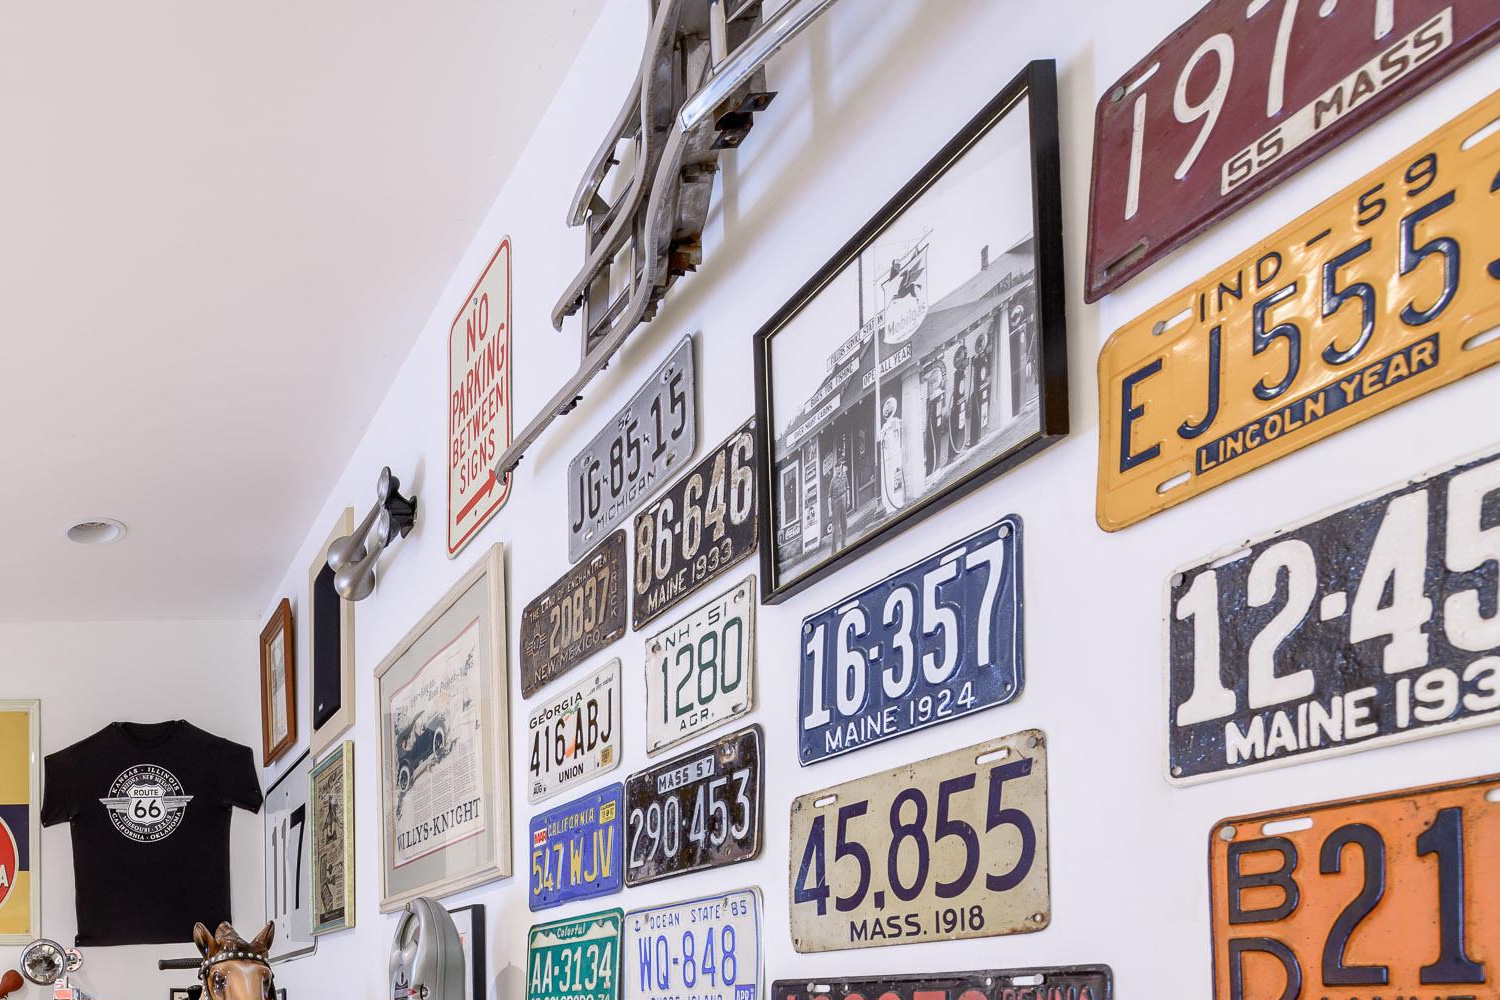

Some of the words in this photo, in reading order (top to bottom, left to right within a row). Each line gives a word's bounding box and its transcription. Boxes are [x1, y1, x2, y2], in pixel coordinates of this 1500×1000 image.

[1313, 16, 1443, 129] MASS
[466, 292, 489, 362] NO
[1120, 169, 1500, 473] EJ555
[452, 322, 505, 435] PARKING
[863, 368, 880, 387] OPE
[880, 360, 892, 375] ALL
[893, 345, 912, 363] YEAR
[452, 376, 504, 470] BETWEEN
[1200, 391, 1327, 471] LINCOLN
[1340, 340, 1434, 404] YEAR
[460, 428, 495, 495] SIGNS
[595, 463, 658, 531] MICHIGAN
[636, 432, 755, 595] 86-646
[610, 559, 619, 618] TRUCK
[648, 571, 687, 615] MAINE
[691, 537, 733, 581] 1933
[529, 607, 540, 623] THE
[550, 565, 610, 659] 20837
[803, 538, 1005, 731] 16-357
[534, 657, 557, 684] NEW
[560, 628, 601, 666] MEXICO
[661, 616, 743, 724] 1280
[529, 691, 583, 730] GEORGIA
[530, 718, 566, 778] 416
[573, 688, 613, 760] ABJ
[679, 708, 715, 732] AGR.
[824, 706, 898, 753] MAINE
[908, 681, 976, 725] 1924
[1225, 686, 1378, 765] MAINE
[111, 768, 138, 794] KANSAS
[147, 766, 180, 791] ILLINOIS
[558, 763, 584, 783] UNION
[658, 766, 689, 791] MASS
[112, 812, 145, 840] CALIFORNIA
[150, 812, 182, 840] OKLAHOMA
[134, 799, 161, 818] 66
[534, 829, 547, 845] MAR
[548, 807, 594, 837] CALIFORNIA
[532, 843, 564, 896] 547
[570, 826, 613, 886] WJV
[556, 922, 586, 938] Colorful
[649, 912, 680, 930] OCEAN
[691, 905, 721, 923] STATE
[731, 899, 747, 917] 85
[849, 913, 928, 942] MASS.
[935, 905, 985, 934] 1918
[638, 924, 737, 992] WQ-848
